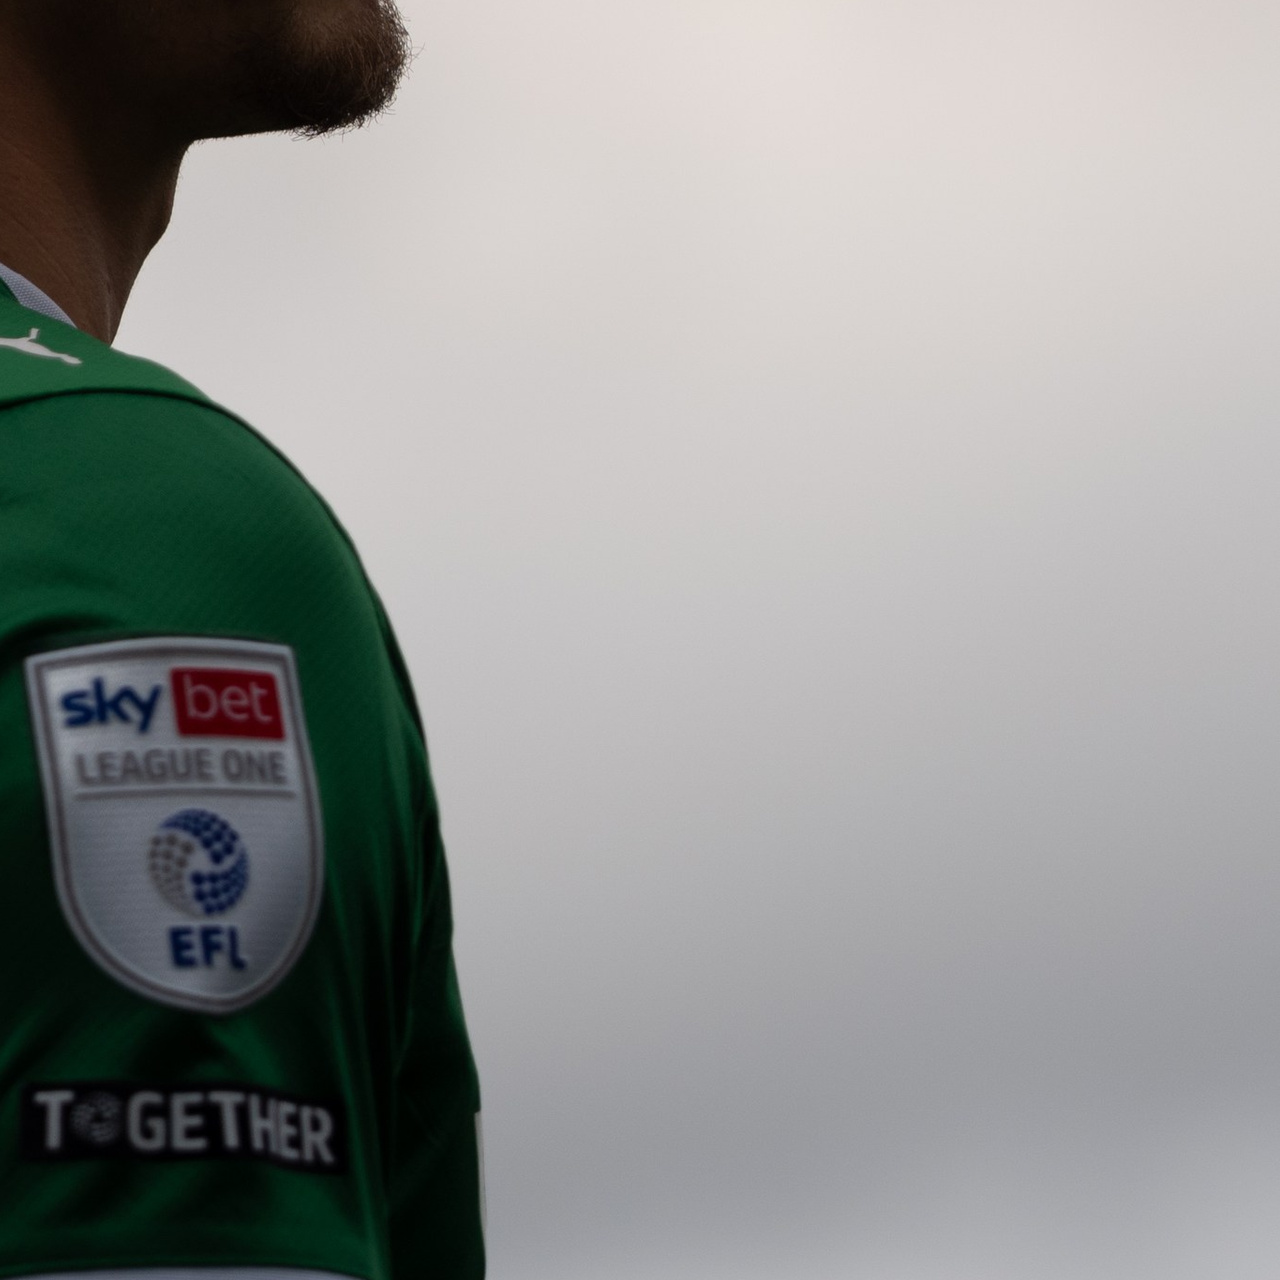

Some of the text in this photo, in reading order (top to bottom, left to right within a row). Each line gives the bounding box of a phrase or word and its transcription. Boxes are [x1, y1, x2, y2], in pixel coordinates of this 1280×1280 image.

[59, 672, 273, 735] sky bet
[75, 748, 286, 787] LEAGUE ONE
[169, 925, 248, 969] EFL
